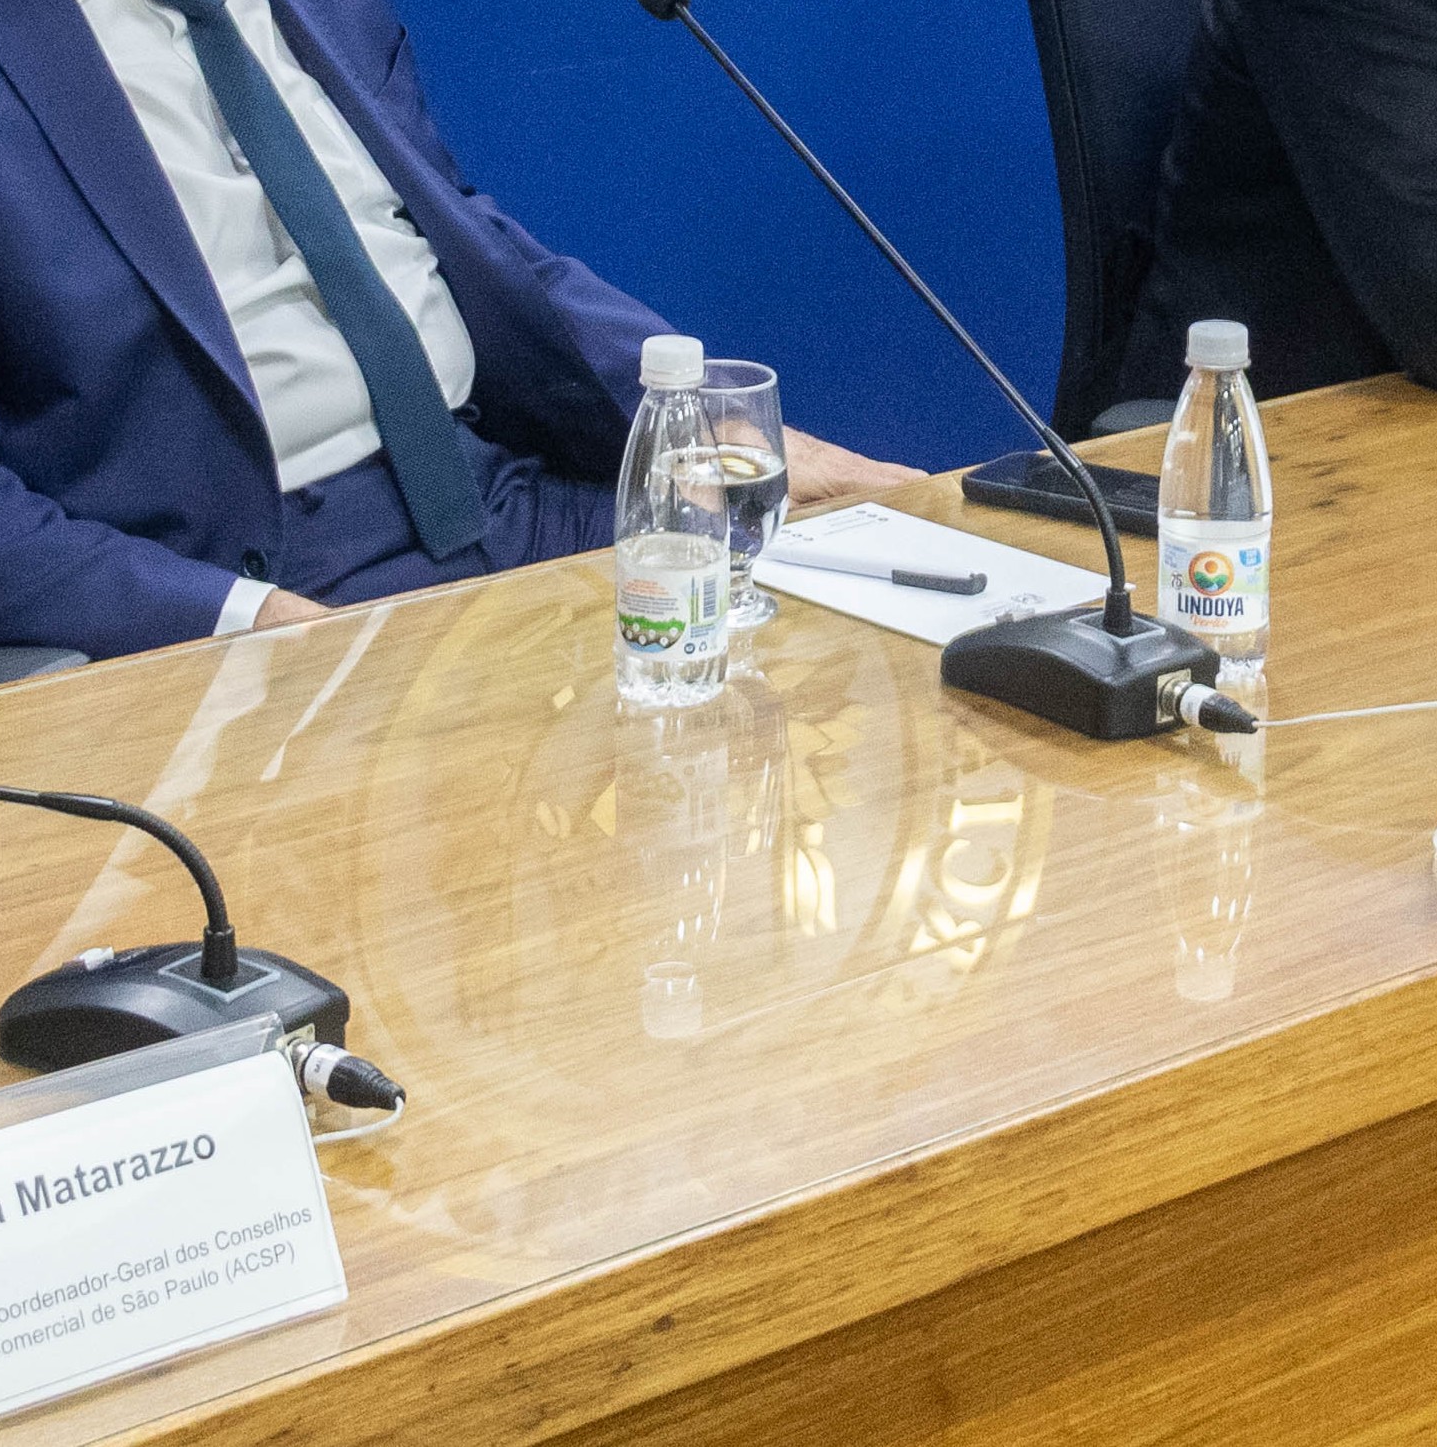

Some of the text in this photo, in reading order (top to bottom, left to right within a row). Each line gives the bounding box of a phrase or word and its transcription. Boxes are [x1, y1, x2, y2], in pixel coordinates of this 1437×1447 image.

[1177, 593, 1244, 617] LINDOYA
[14, 1134, 217, 1217] Matarazzo
[175, 1240, 210, 1265] dos
[214, 1206, 313, 1252] Conselhos
[91, 1304, 116, 1325] de
[121, 1288, 160, 1314] São
[164, 1268, 220, 1300] Paulo
[224, 1240, 296, 1285] (ACSP)
